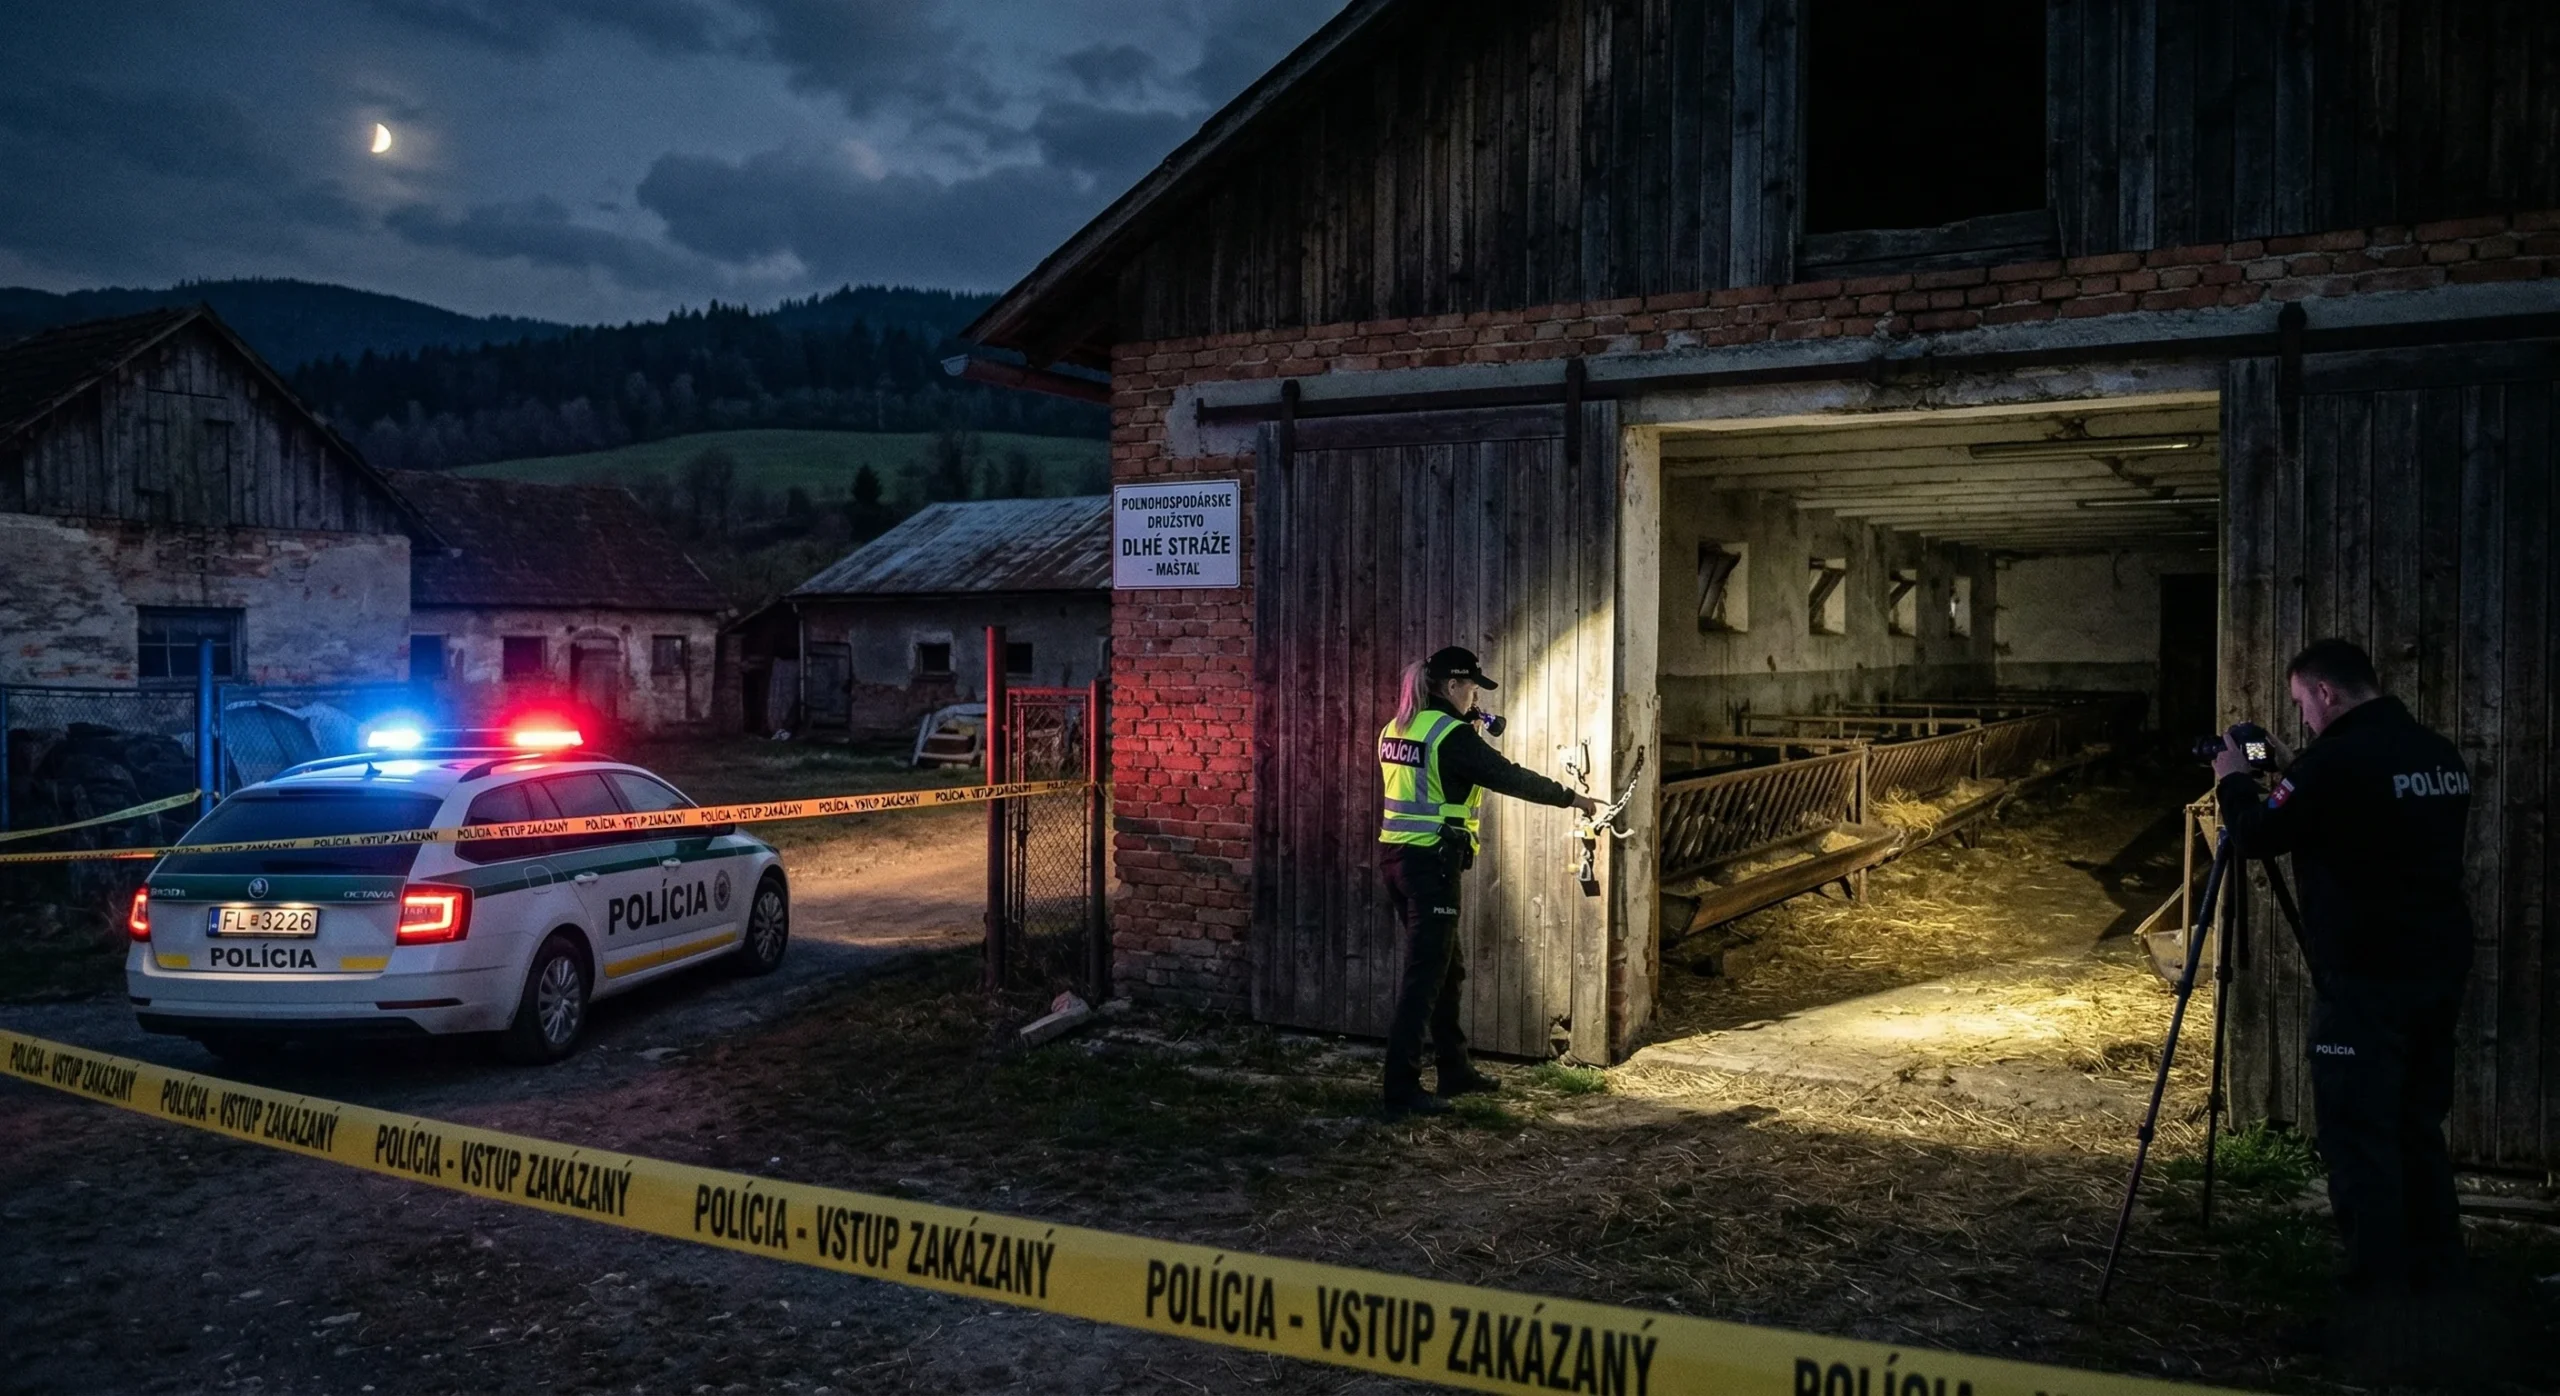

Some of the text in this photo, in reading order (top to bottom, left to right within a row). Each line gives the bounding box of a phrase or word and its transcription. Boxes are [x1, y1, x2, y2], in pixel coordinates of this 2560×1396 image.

[1147, 512, 1204, 528] DRUŽSTVO
[1122, 531, 1231, 556] DLHÉ STRÁŽE
[1381, 739, 1420, 763] POLÍCIA
[2392, 765, 2470, 799] POLÍCIA
[343, 890, 395, 899] OCTAVIA
[608, 878, 708, 936] POLÍCIA
[222, 911, 312, 931] FL 3226
[210, 943, 317, 969] POLÍCIA
[2315, 1043, 2356, 1056] POLÍCIA
[9, 1038, 46, 1078] POLÍCIA
[51, 1051, 84, 1084] VSTUP
[82, 1056, 140, 1103] ZAKÁZANÝ
[160, 1075, 207, 1122] POLÍCIA
[219, 1090, 263, 1135] VSTUP
[263, 1097, 341, 1152] ZAKÁZANÝ
[374, 1121, 442, 1178] POLÍCIA
[461, 1139, 522, 1194] VSTUP
[525, 1149, 633, 1217] ZAKÁZANÝ
[694, 1180, 788, 1251] POLÍCIA
[816, 1203, 900, 1270] VSTUP
[907, 1216, 1056, 1299] ZAKÁZANÝ
[1146, 1254, 1277, 1341] POLÍCIA
[1317, 1285, 1436, 1367] VSTUP
[1447, 1303, 1659, 1396] ZAKÁZANÝ
